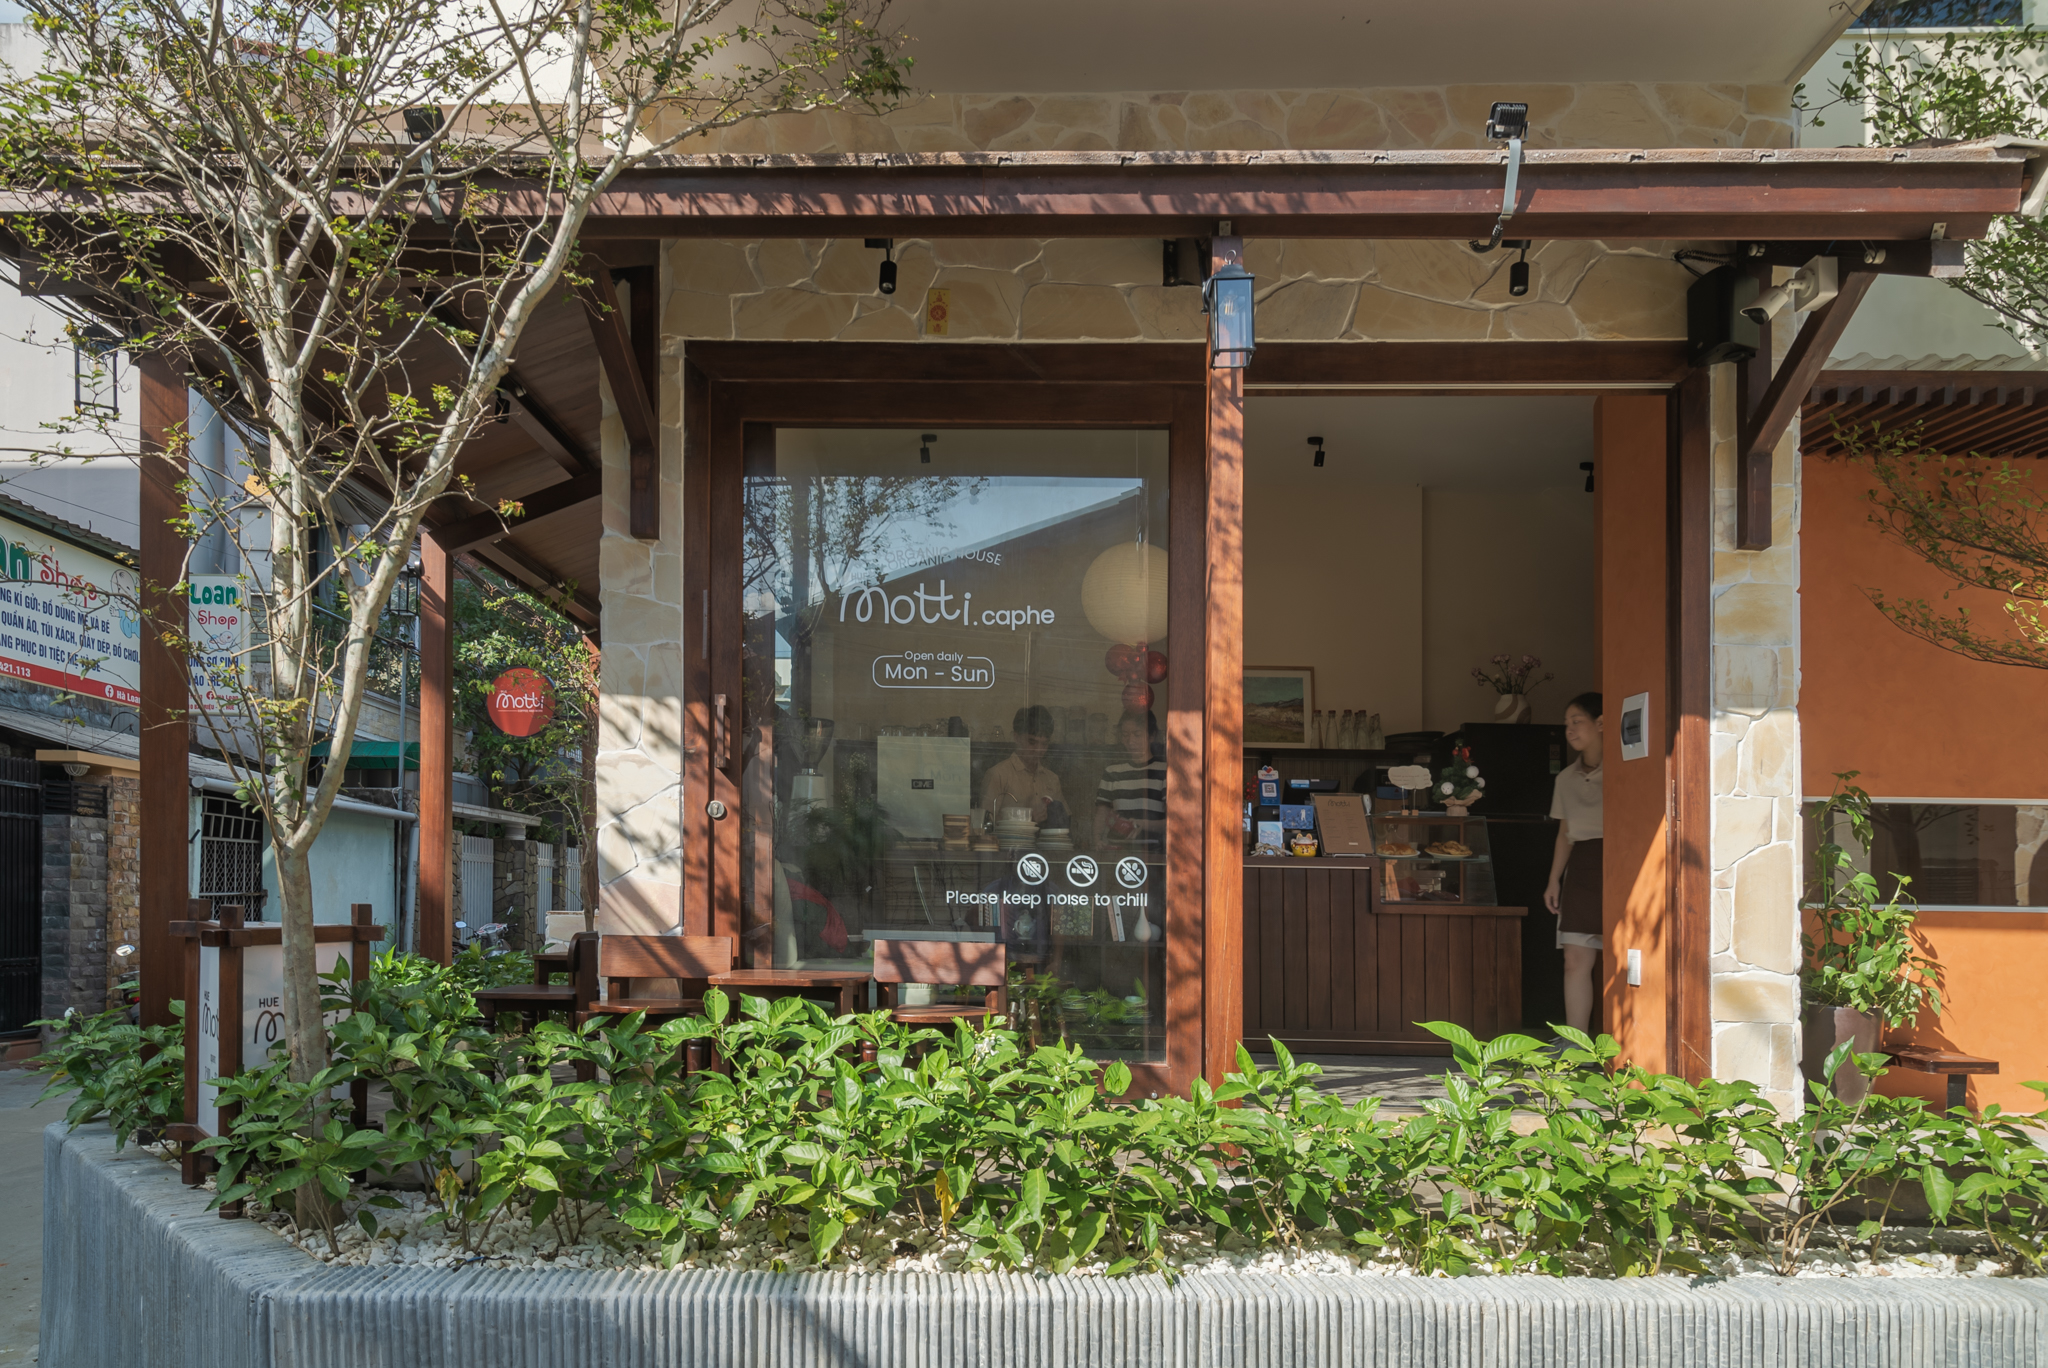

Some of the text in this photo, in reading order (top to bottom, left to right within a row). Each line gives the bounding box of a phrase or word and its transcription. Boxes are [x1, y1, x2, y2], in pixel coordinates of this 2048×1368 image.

[955, 547, 1002, 566] HOUSE
[40, 553, 97, 608] Shop
[190, 583, 238, 605] Loan
[55, 604, 76, 623] DÙNG
[90, 615, 100, 631] VÀ
[101, 619, 110, 635] BÉ
[198, 609, 238, 630] Shop
[41, 621, 53, 638] TÚI
[55, 625, 78, 647] XÁCH,
[15, 637, 37, 657] PHỤC
[39, 643, 47, 659] ĐI
[48, 645, 66, 665] TIỆC
[904, 651, 963, 664] Open daily
[885, 664, 927, 680] Mon
[951, 666, 988, 682] Sun
[116, 690, 126, 701] Hà
[946, 890, 1148, 909] Please keep noise to chill
[259, 997, 280, 1008] HUE
